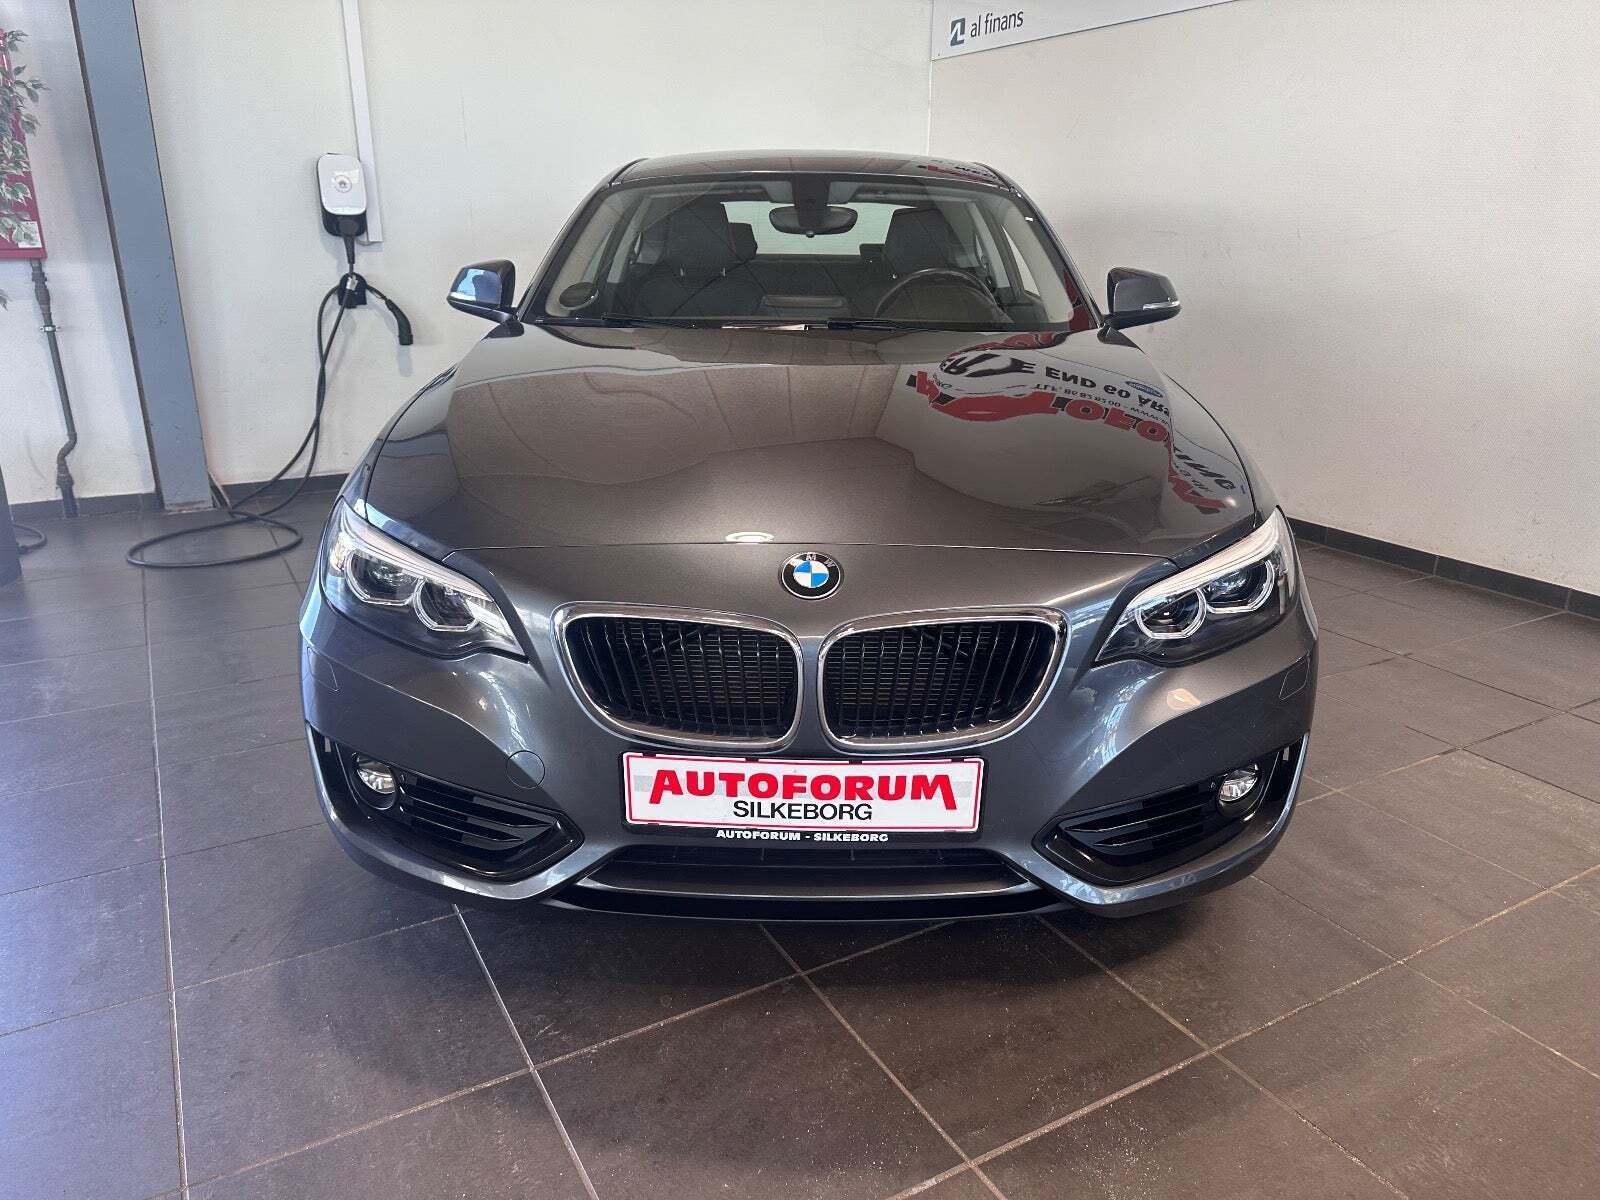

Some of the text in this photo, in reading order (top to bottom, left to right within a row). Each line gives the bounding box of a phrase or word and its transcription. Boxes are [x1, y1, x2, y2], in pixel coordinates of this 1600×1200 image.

[970, 10, 1024, 37] al finans
[649, 769, 957, 810] AUTOFORUM
[733, 800, 873, 820] SILKEBORG
[716, 829, 800, 841] AUTOFORUM
[813, 832, 889, 842] SILKEBORG
